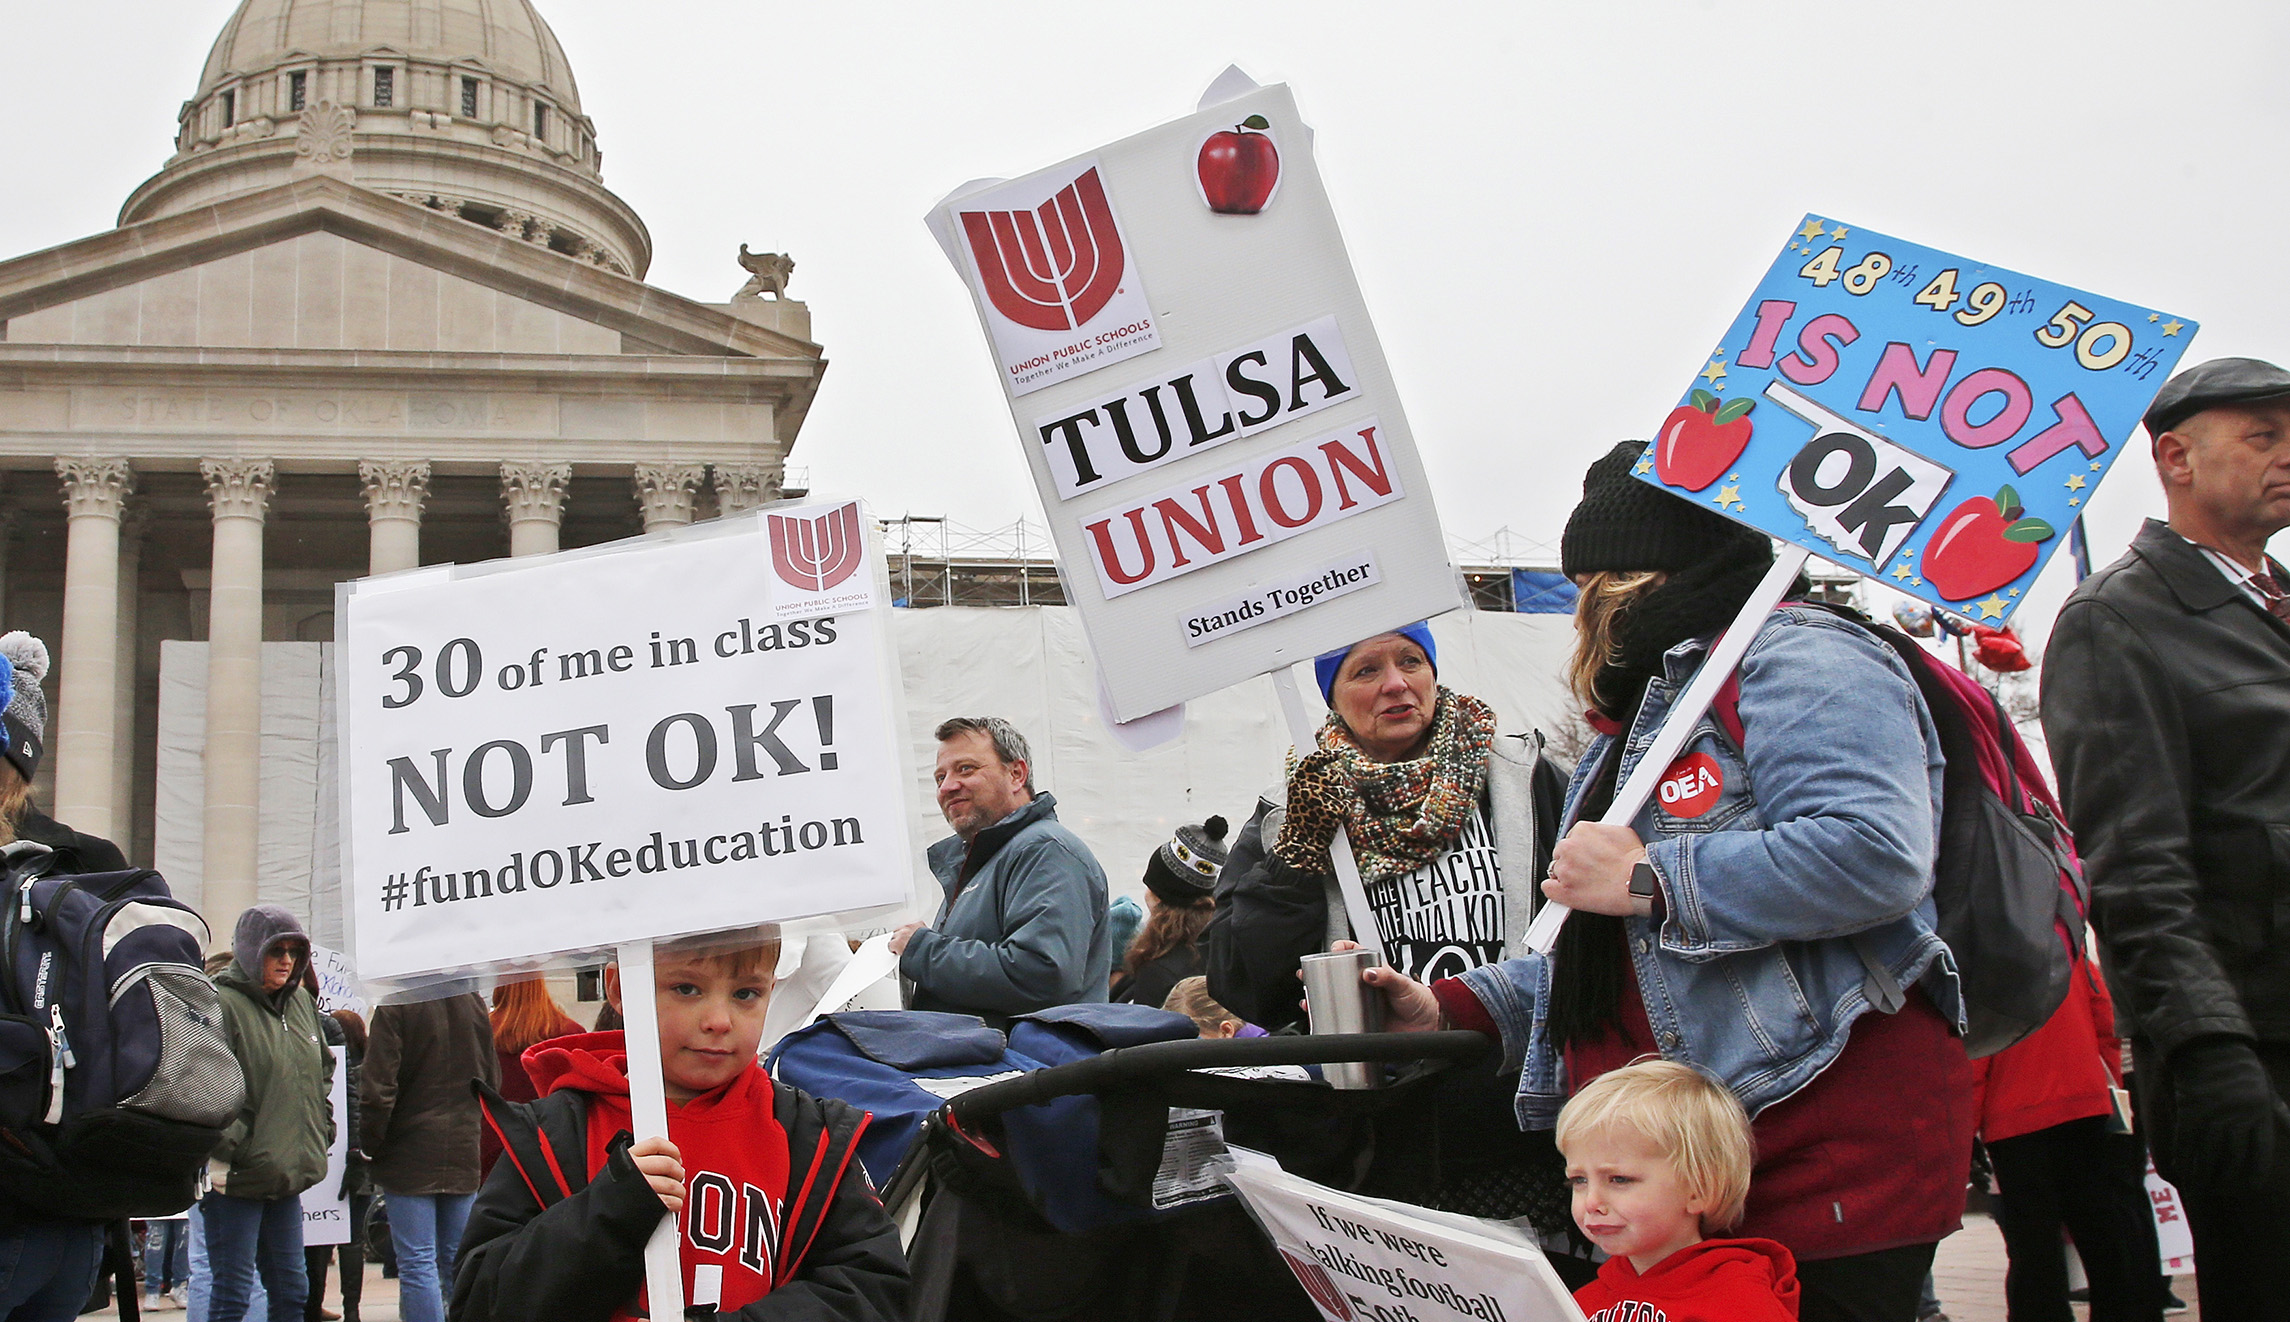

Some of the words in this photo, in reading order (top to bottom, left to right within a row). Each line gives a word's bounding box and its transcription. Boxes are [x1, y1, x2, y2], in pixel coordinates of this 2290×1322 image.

[1010, 355, 1050, 375] UNION
[1053, 339, 1093, 360] PUBLIC
[1095, 319, 1150, 346] SCHOOLS
[1015, 368, 1053, 385] Together
[1055, 361, 1070, 371] We
[1072, 353, 1096, 365] Make
[1098, 348, 1104, 356] A
[1106, 333, 1153, 354] Difference
[119, 398, 223, 421] STATE
[250, 399, 292, 422] OF
[1039, 333, 1352, 488] TULSA
[1735, 299, 1860, 387] IS
[1856, 341, 2110, 477] NOT
[1085, 425, 1393, 586] UNION
[775, 602, 802, 611] UNION
[804, 598, 830, 607] PUBLIC
[832, 593, 868, 603] SCHOOLS
[1187, 600, 1266, 639] Stands
[1266, 561, 1372, 611] Together
[382, 637, 483, 709] 30
[498, 647, 548, 690] of
[559, 644, 633, 681] me
[649, 631, 699, 669] in
[713, 617, 838, 657] class
[386, 723, 609, 835] NOT
[645, 695, 839, 791] OK!
[1660, 766, 1719, 804] OEA
[381, 814, 864, 911] #fundOKeducation
[1306, 1203, 1336, 1233] If
[1333, 1216, 1375, 1245] we
[1373, 1228, 1448, 1268] were
[1305, 1240, 1403, 1298] talking
[1396, 1267, 1508, 1322] football
